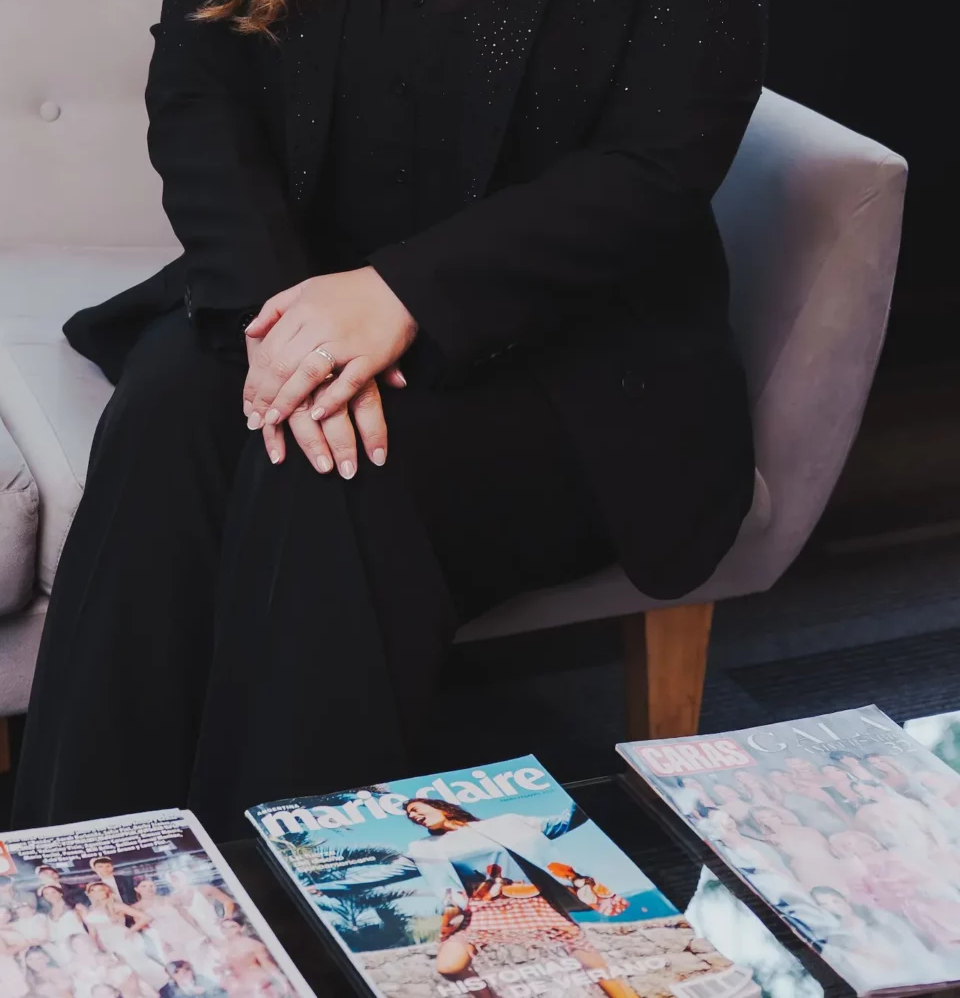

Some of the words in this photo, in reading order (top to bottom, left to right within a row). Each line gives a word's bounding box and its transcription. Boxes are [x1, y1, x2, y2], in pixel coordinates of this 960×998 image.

[640, 740, 750, 774] CARAS
[256, 803, 301, 817] ARGENTINA
[261, 790, 411, 838] marie
[415, 767, 551, 805] claire
[437, 957, 583, 996] HISTORIAS
